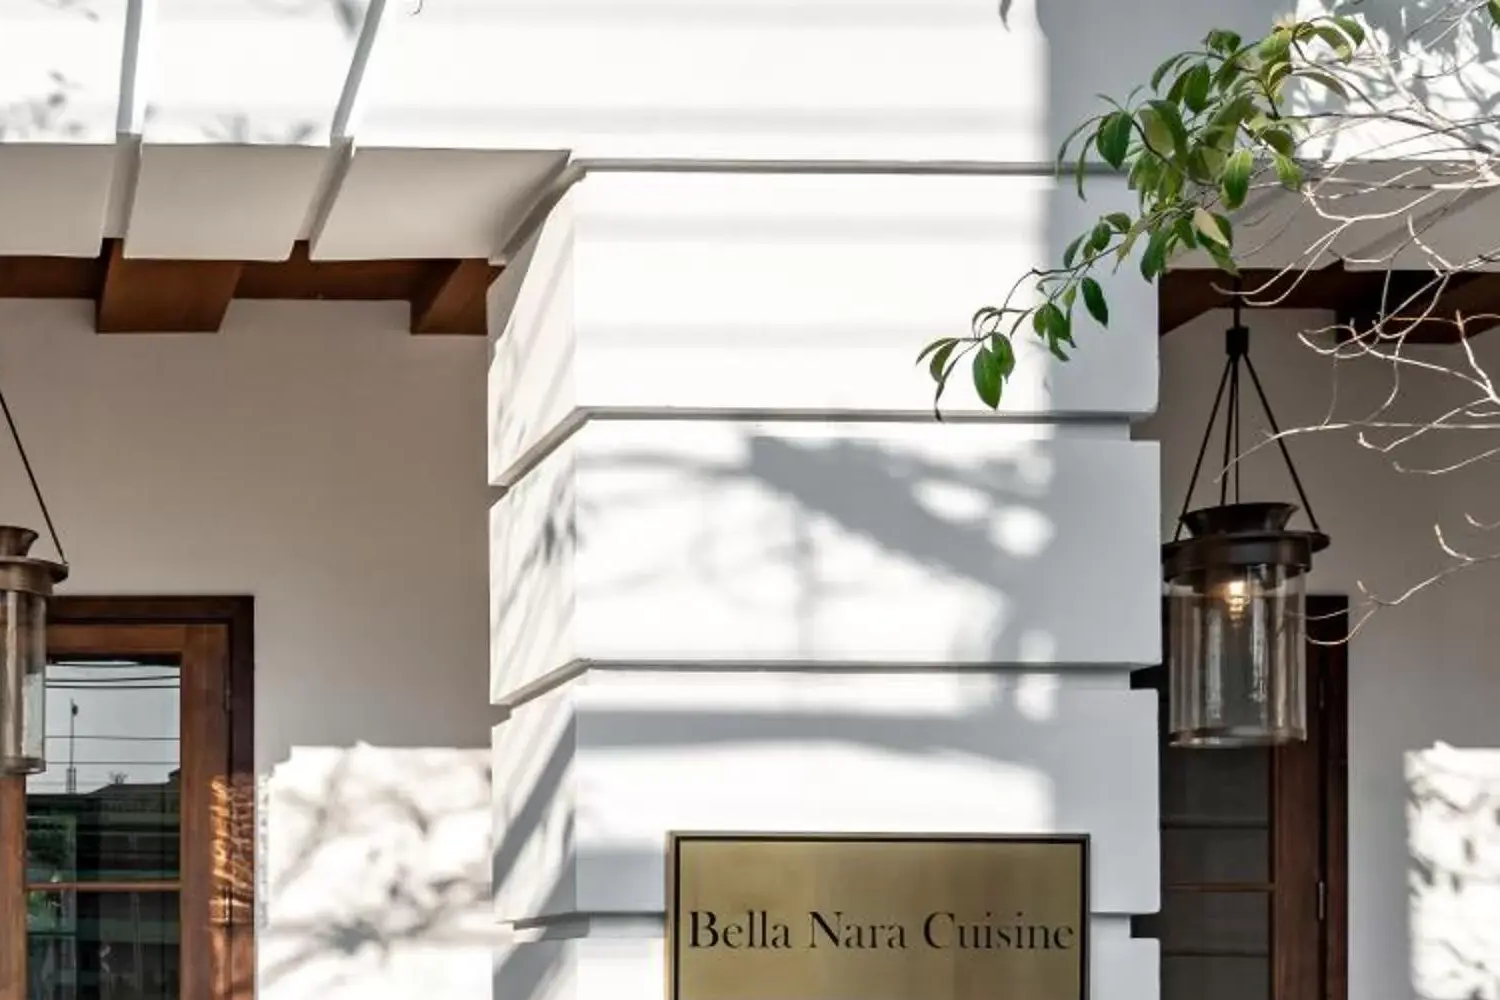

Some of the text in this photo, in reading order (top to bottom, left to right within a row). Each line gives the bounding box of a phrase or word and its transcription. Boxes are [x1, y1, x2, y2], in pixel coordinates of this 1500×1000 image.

[687, 910, 1076, 950] Bella Nara Cuisine
